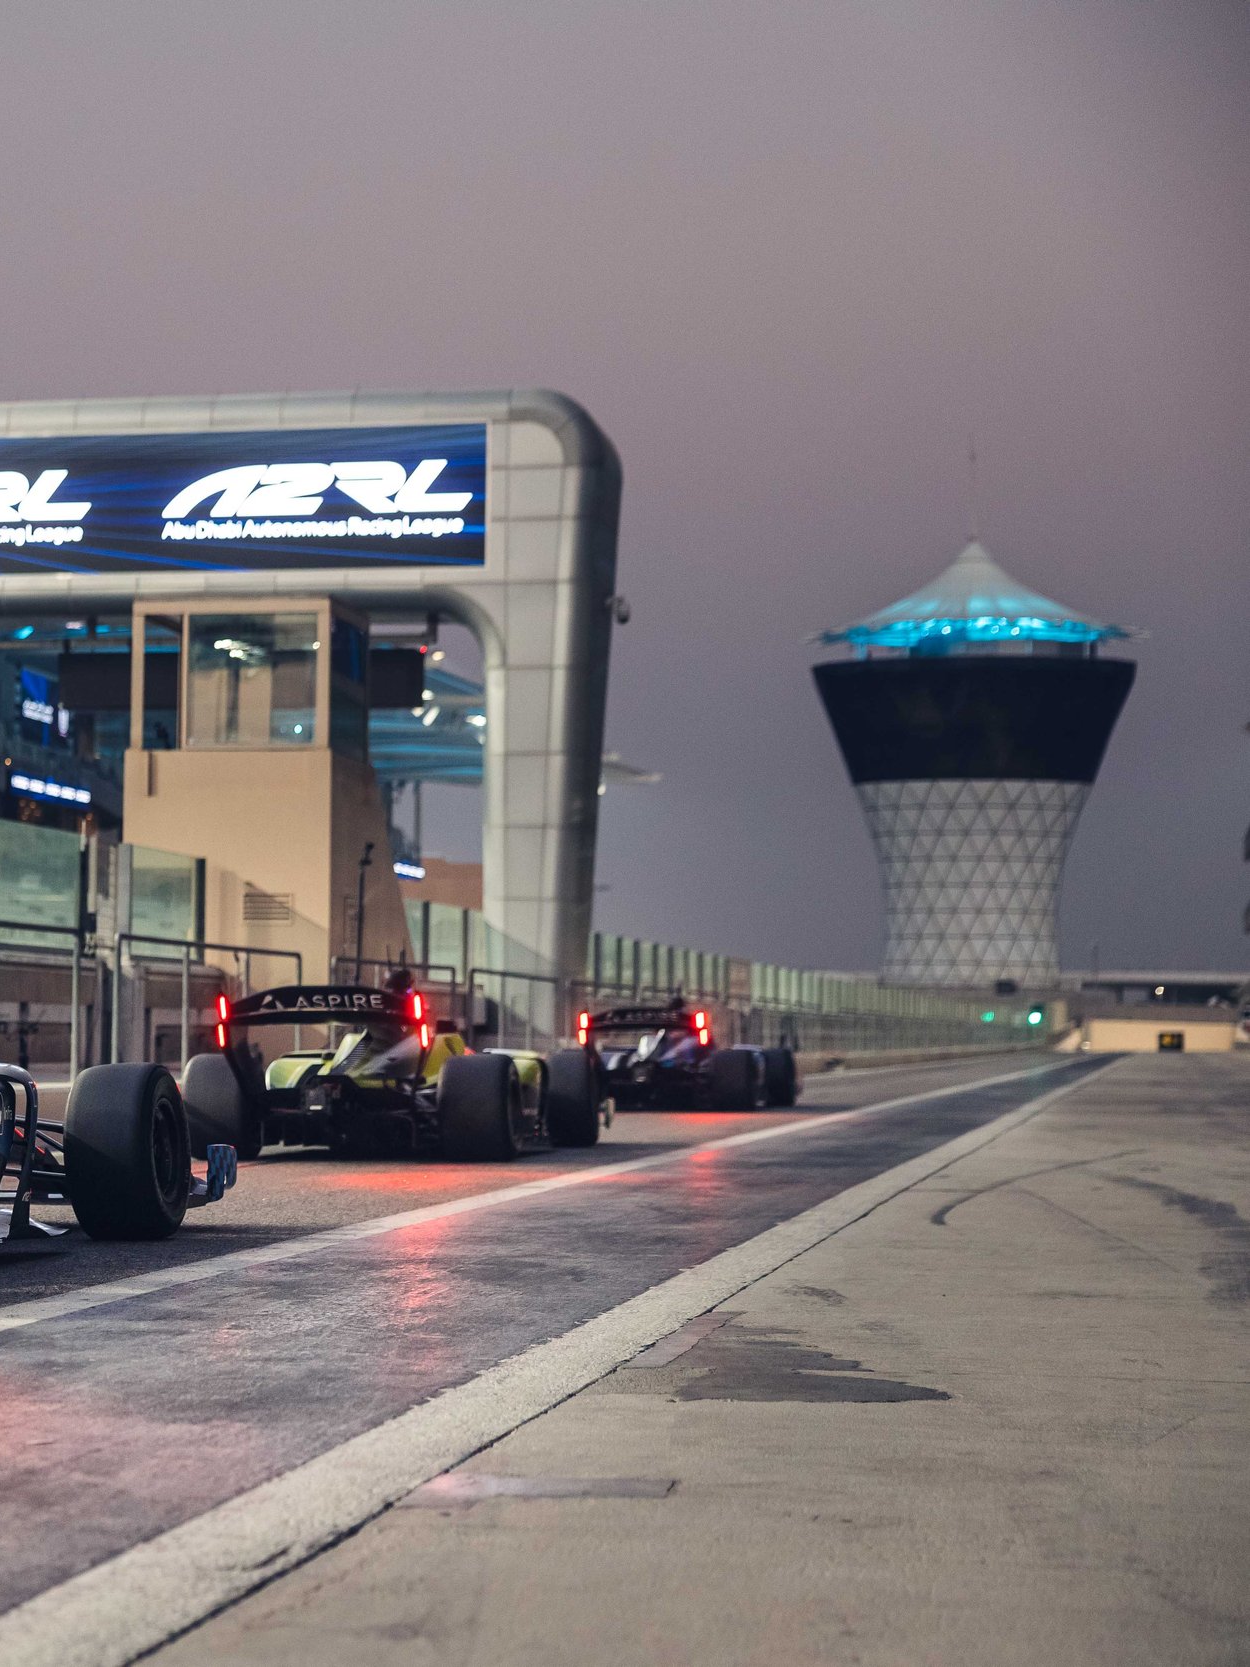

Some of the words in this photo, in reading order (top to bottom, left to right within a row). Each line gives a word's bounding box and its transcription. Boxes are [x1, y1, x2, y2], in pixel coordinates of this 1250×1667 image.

[25, 524, 83, 545] League
[162, 521, 196, 539] Abu
[196, 520, 243, 539] Dhabi
[243, 519, 347, 538] Autonomous
[347, 516, 401, 538] Racing
[401, 516, 464, 537] League
[296, 994, 383, 1010] ASPIRE
